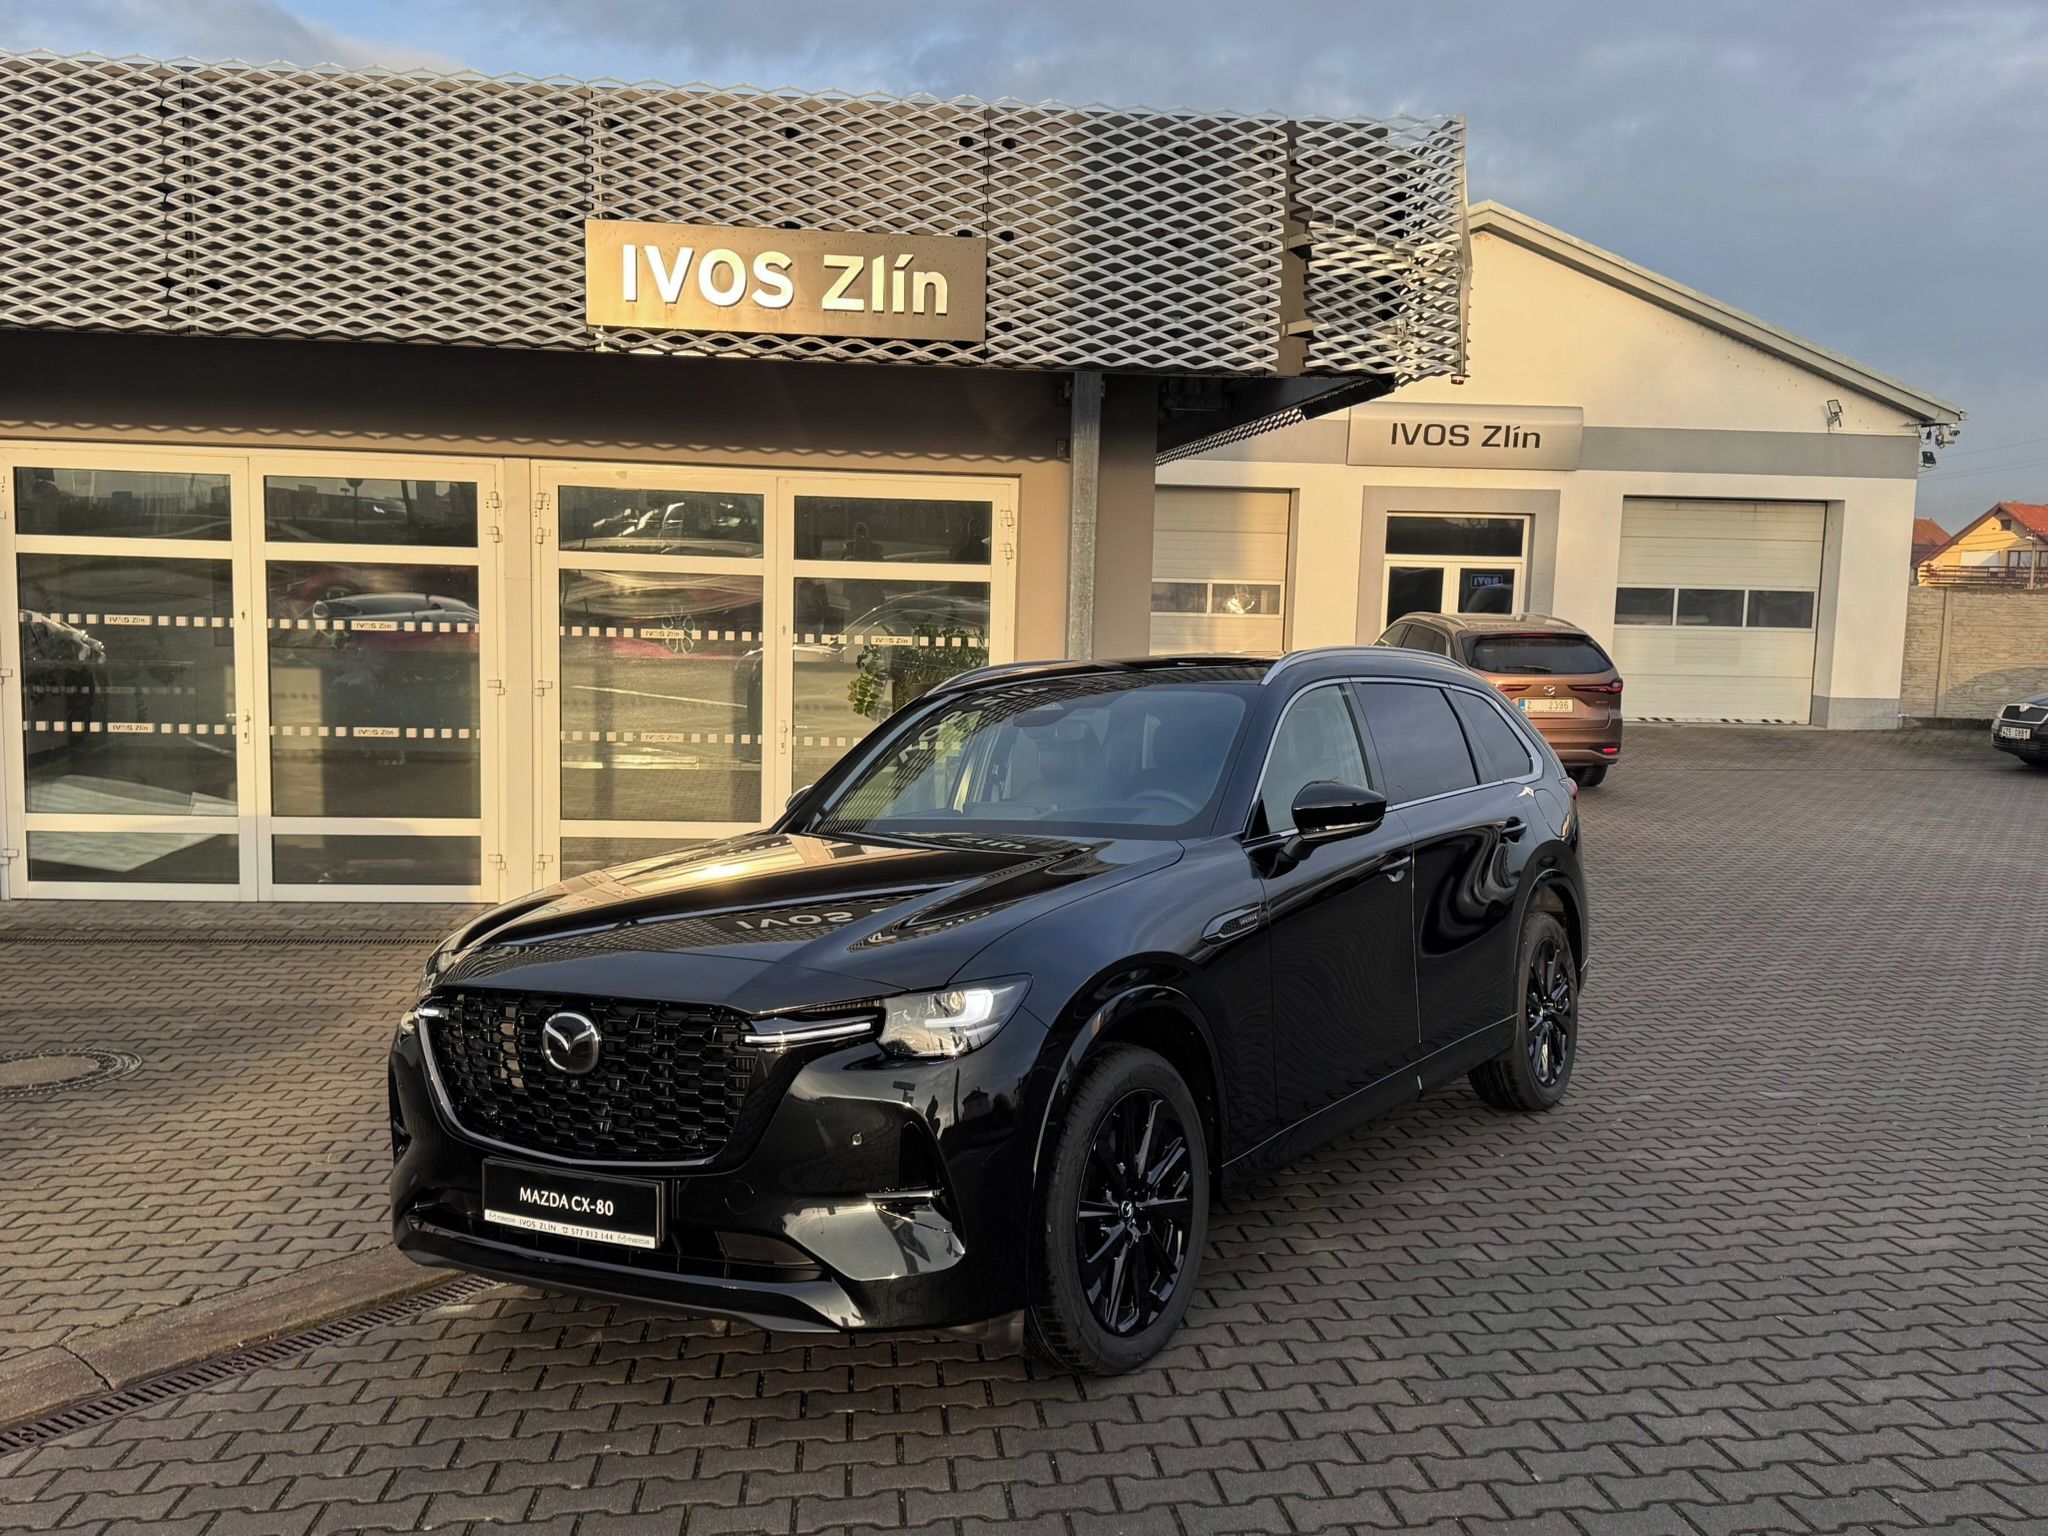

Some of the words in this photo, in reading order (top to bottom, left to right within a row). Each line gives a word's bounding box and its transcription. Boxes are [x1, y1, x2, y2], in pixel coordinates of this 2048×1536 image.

[622, 244, 794, 309] IVOS
[821, 254, 949, 315] Zlín
[1391, 422, 1470, 447] IVOS
[1481, 424, 1542, 449] Zlín
[519, 1187, 569, 1210] MAZDA
[571, 1196, 614, 1216] CX-80
[519, 1219, 536, 1229] IVOS
[585, 1231, 598, 1239] 912
